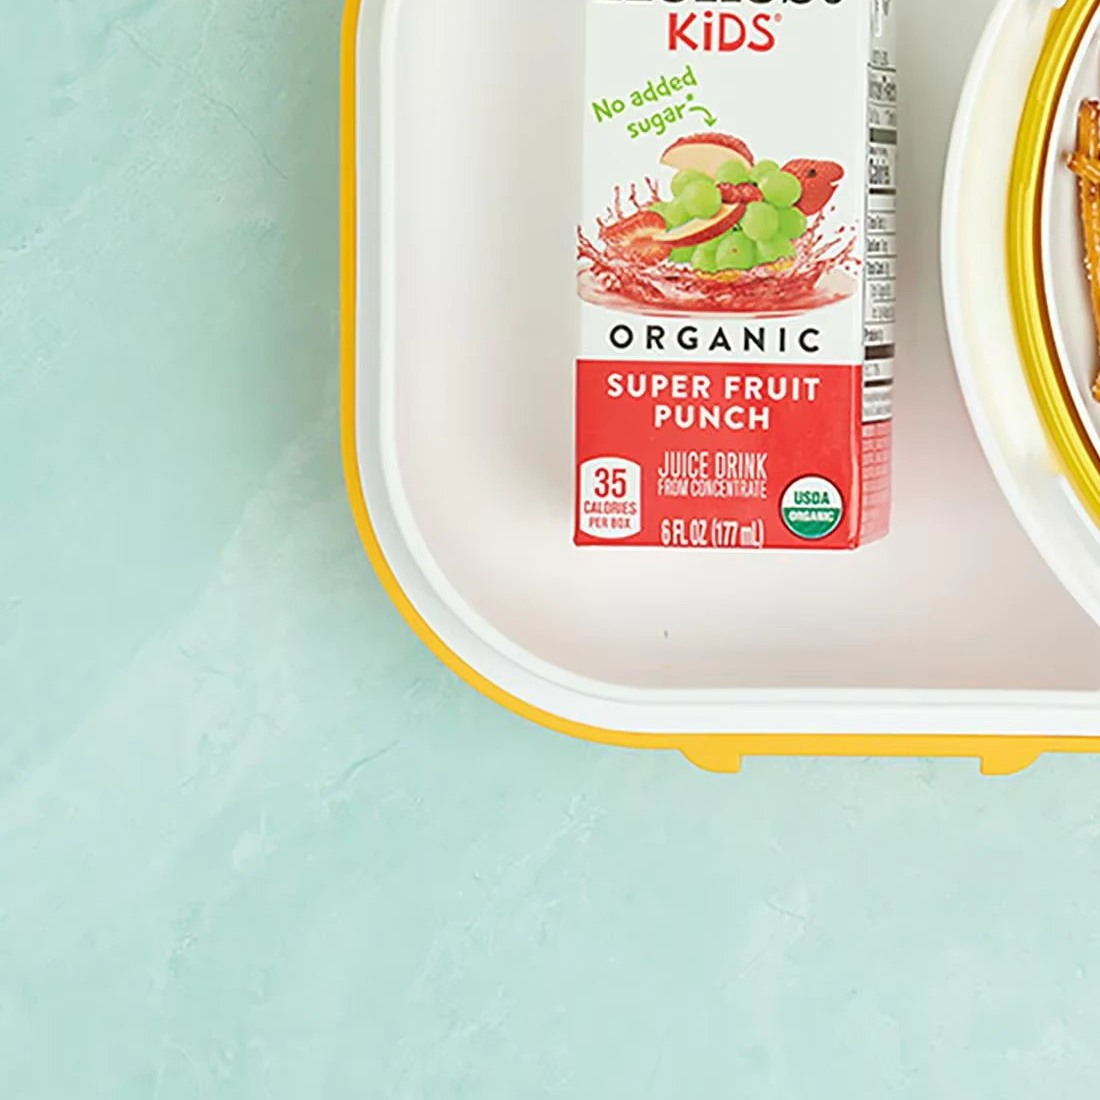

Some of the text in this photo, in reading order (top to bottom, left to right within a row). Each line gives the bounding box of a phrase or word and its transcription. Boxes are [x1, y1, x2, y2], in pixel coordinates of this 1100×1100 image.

[592, 65, 698, 123] No added
[609, 324, 820, 353] ORGANIC
[607, 373, 821, 401] SUPER FRUIT
[655, 404, 770, 430] PUNCH
[657, 451, 768, 480] JUICE DRINK
[594, 467, 627, 498] 35
[657, 478, 767, 499] FROM CONCENTRATE
[583, 500, 638, 515] CALORIES
[793, 490, 831, 506] USDA
[588, 516, 632, 530] PER BOX
[788, 509, 835, 524] ORGANIC
[661, 518, 671, 545] 6
[672, 518, 688, 546] FL
[689, 518, 707, 546] OZ
[711, 517, 738, 549] (177
